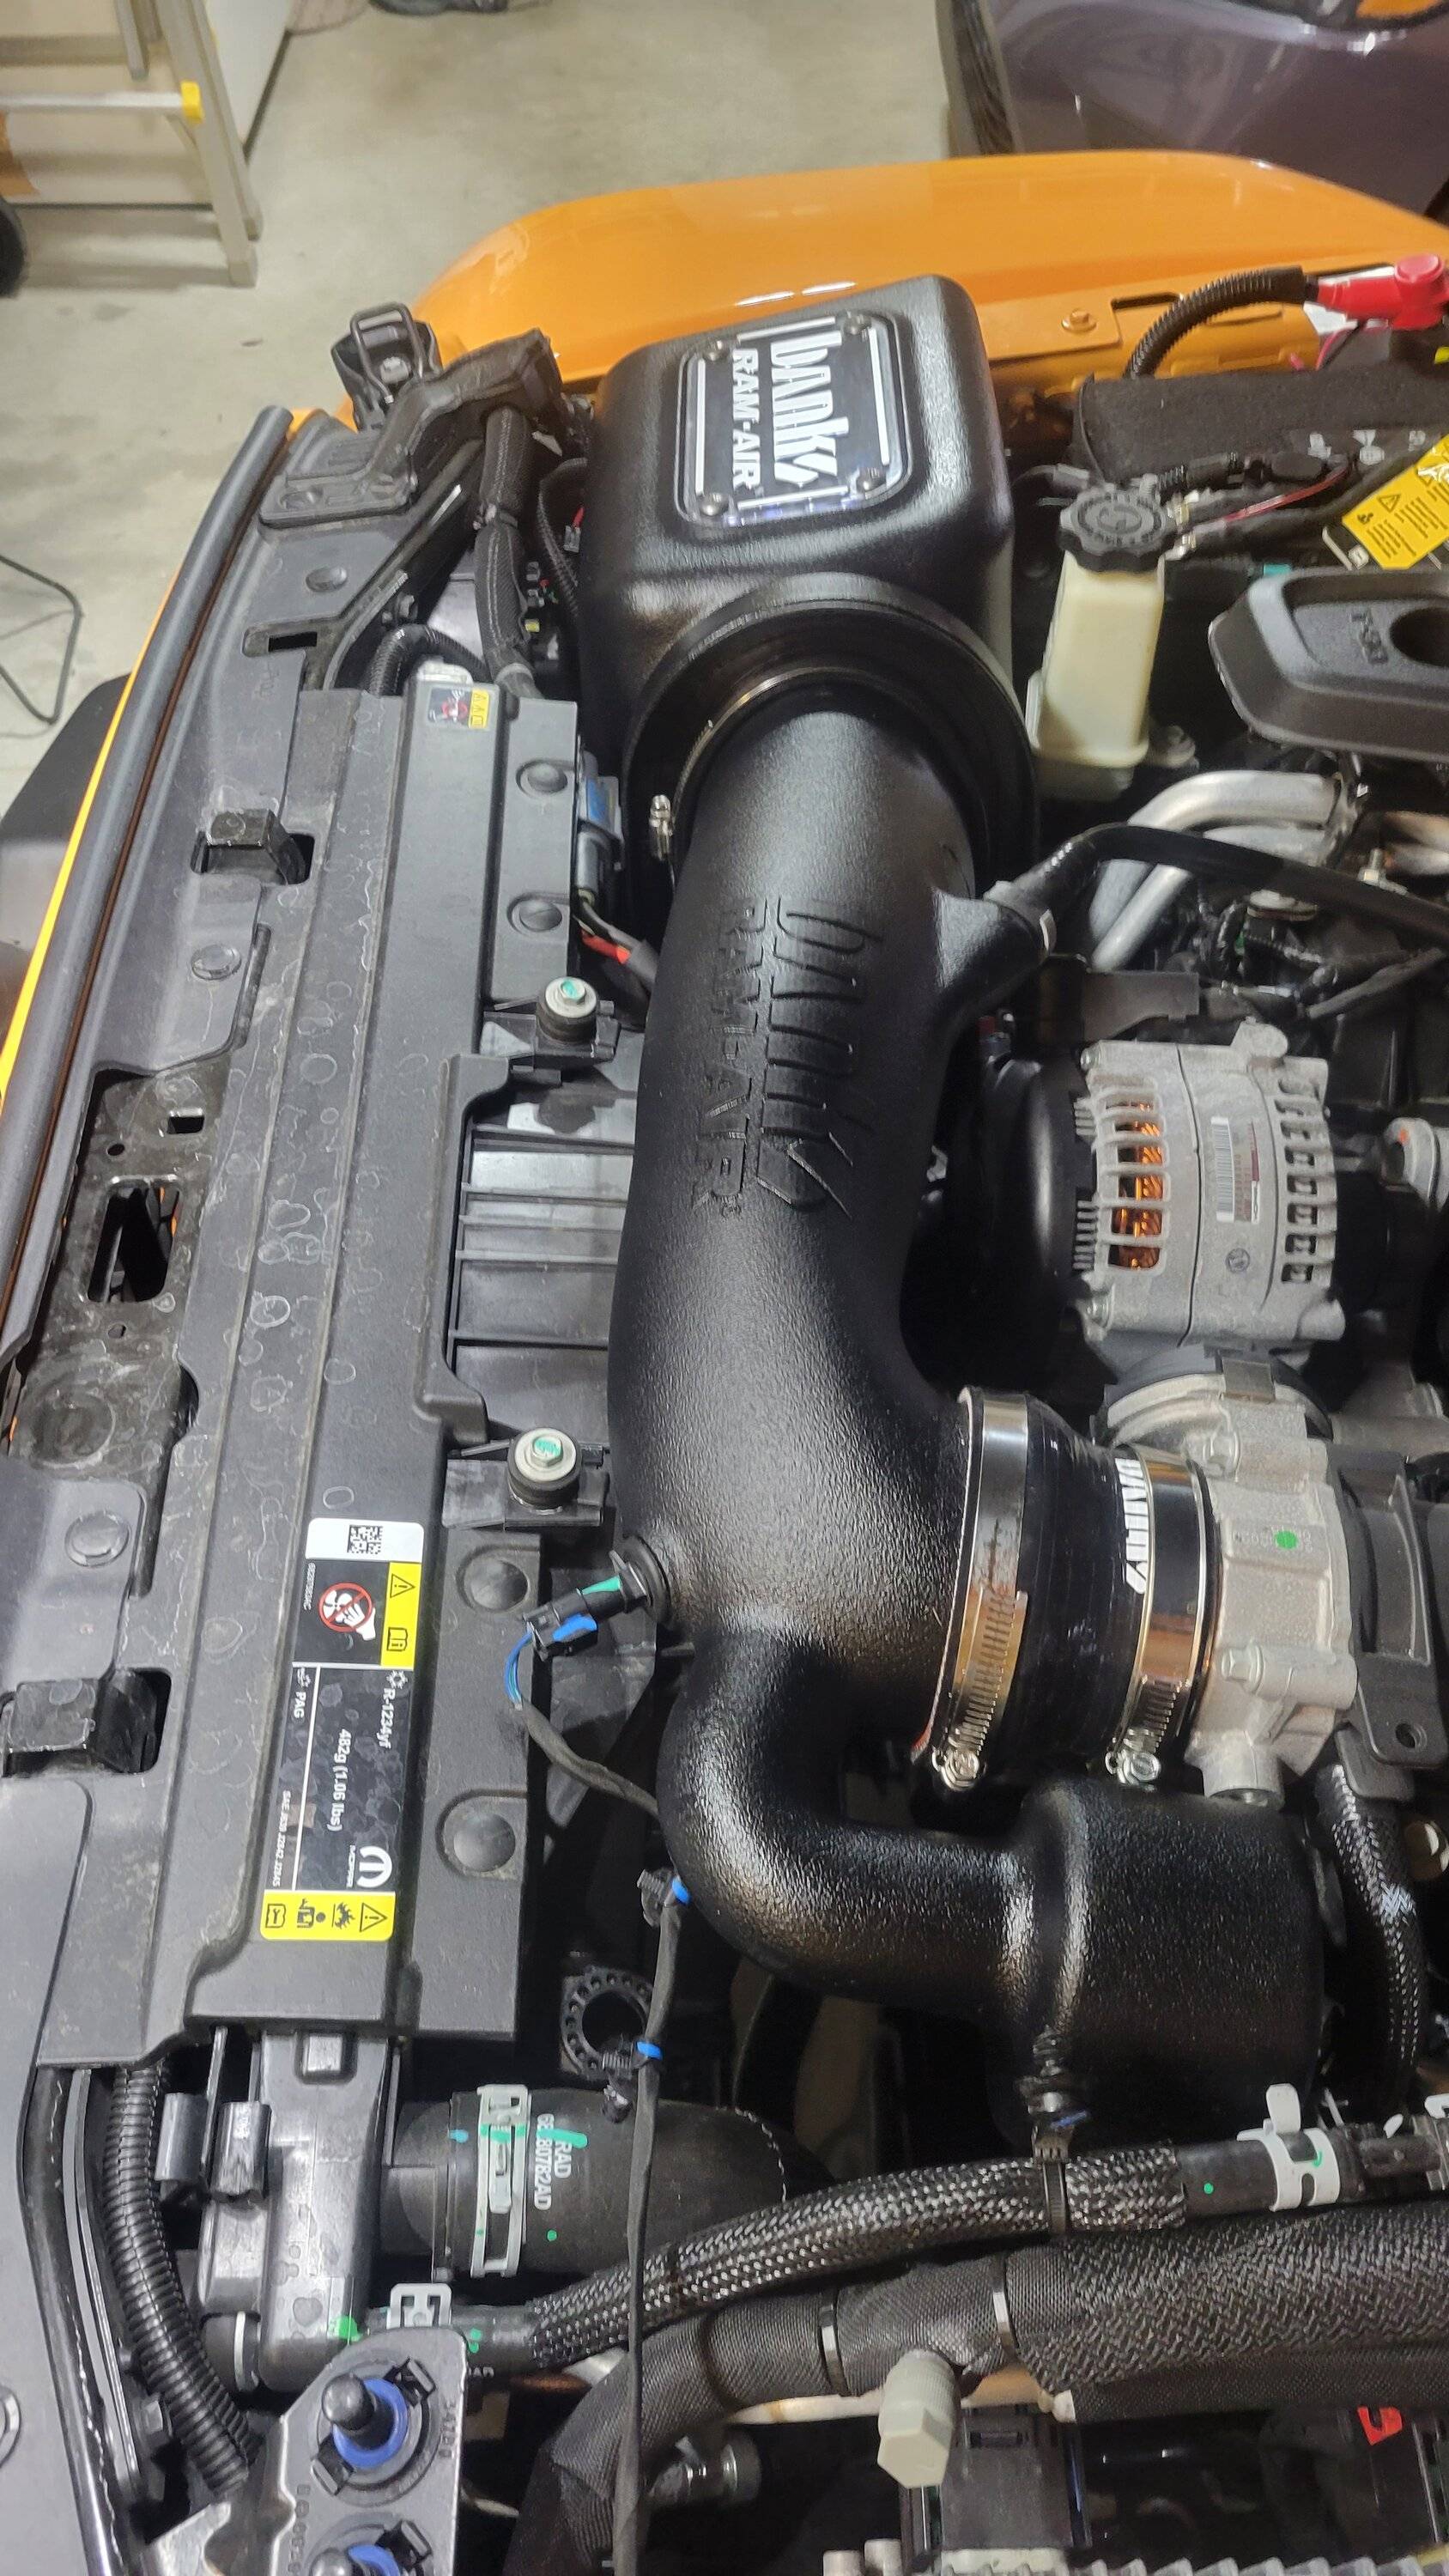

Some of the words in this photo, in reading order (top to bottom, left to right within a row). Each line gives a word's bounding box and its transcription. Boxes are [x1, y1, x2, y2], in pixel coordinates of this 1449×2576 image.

[731, 348, 761, 491] RAM-AIR
[693, 897, 768, 1213] RAM-AIR
[294, 1691, 306, 1718] PAG
[376, 1687, 396, 1749] R-1234yf
[333, 1728, 352, 1764] 482g
[281, 1789, 292, 1811] SAE
[331, 1765, 349, 1801] (1.06
[326, 1802, 344, 1832] lbs)
[534, 2113, 555, 2210] 6880782AD
[554, 2137, 573, 2179] RAD
